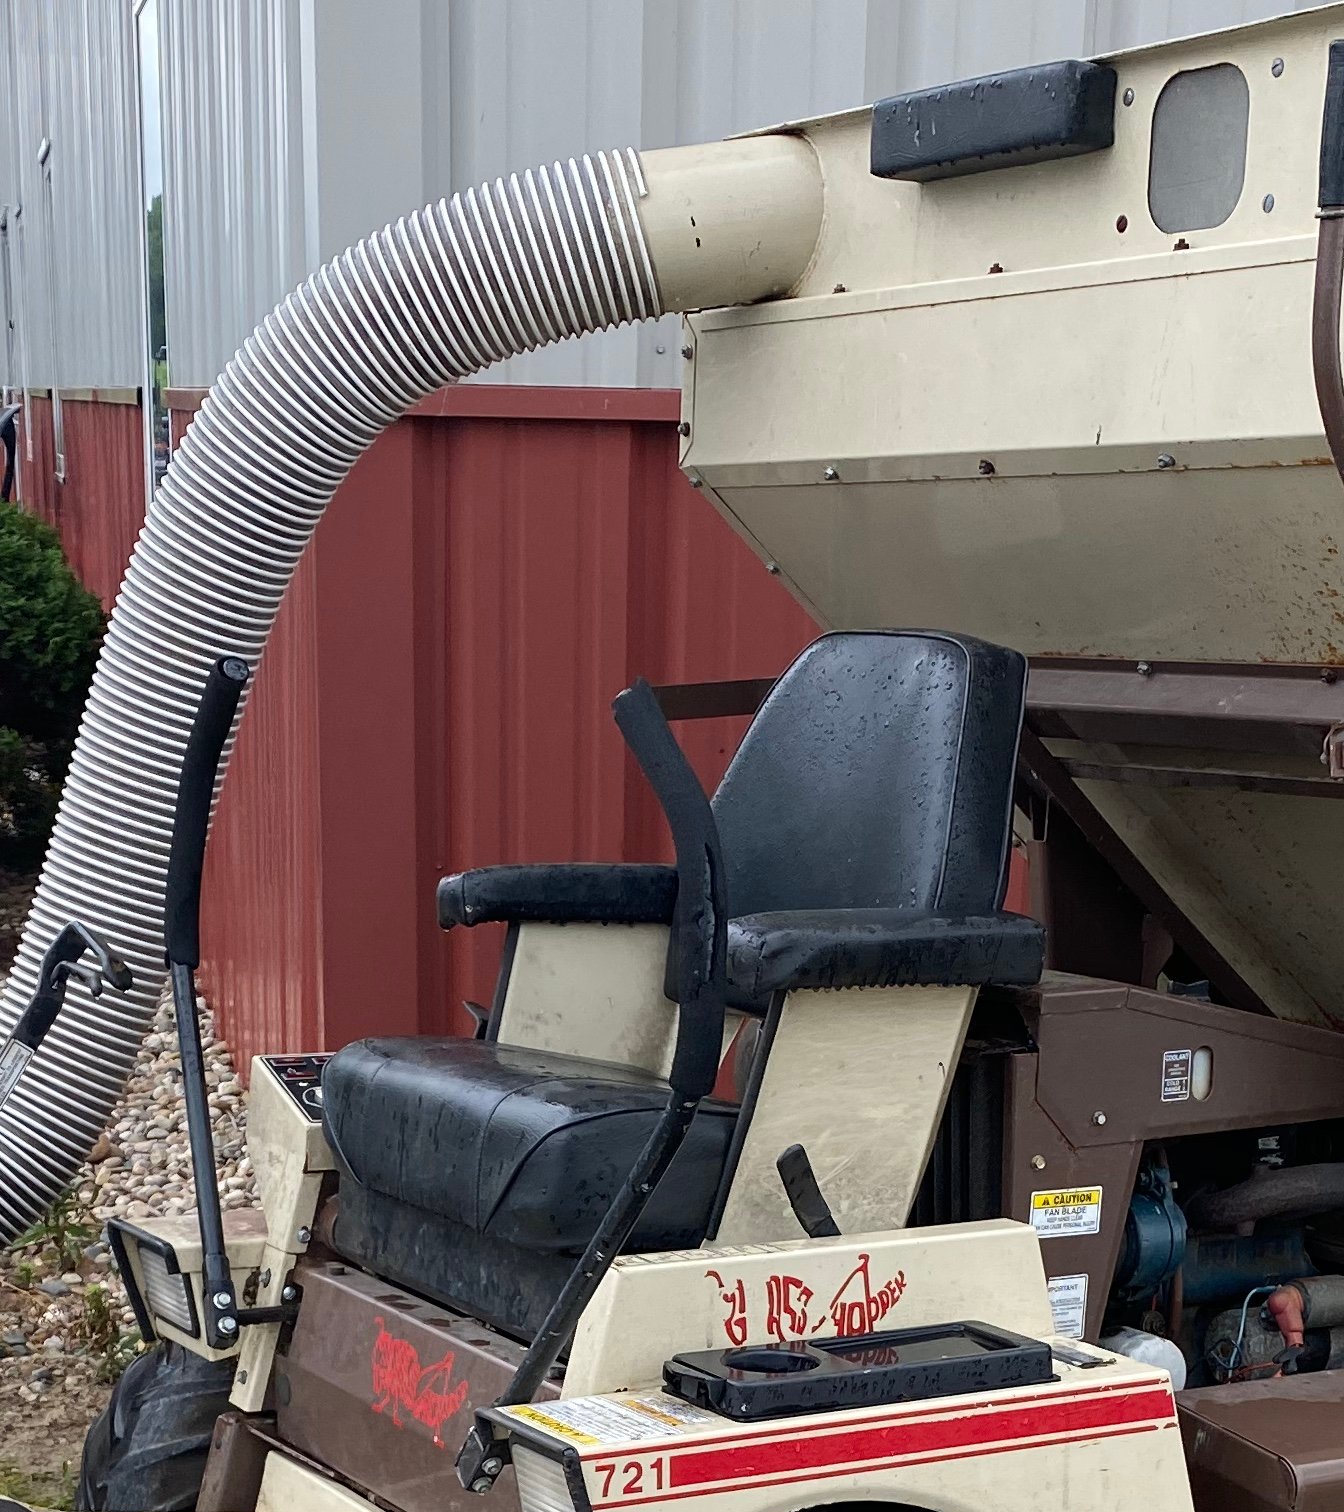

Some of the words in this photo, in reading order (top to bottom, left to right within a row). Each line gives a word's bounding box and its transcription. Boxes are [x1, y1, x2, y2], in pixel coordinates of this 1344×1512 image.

[1053, 1191, 1092, 1205] CAUTION
[1044, 1208, 1060, 1217] FAN
[1061, 1206, 1087, 1215] BLADE
[594, 1457, 663, 1498] 721
